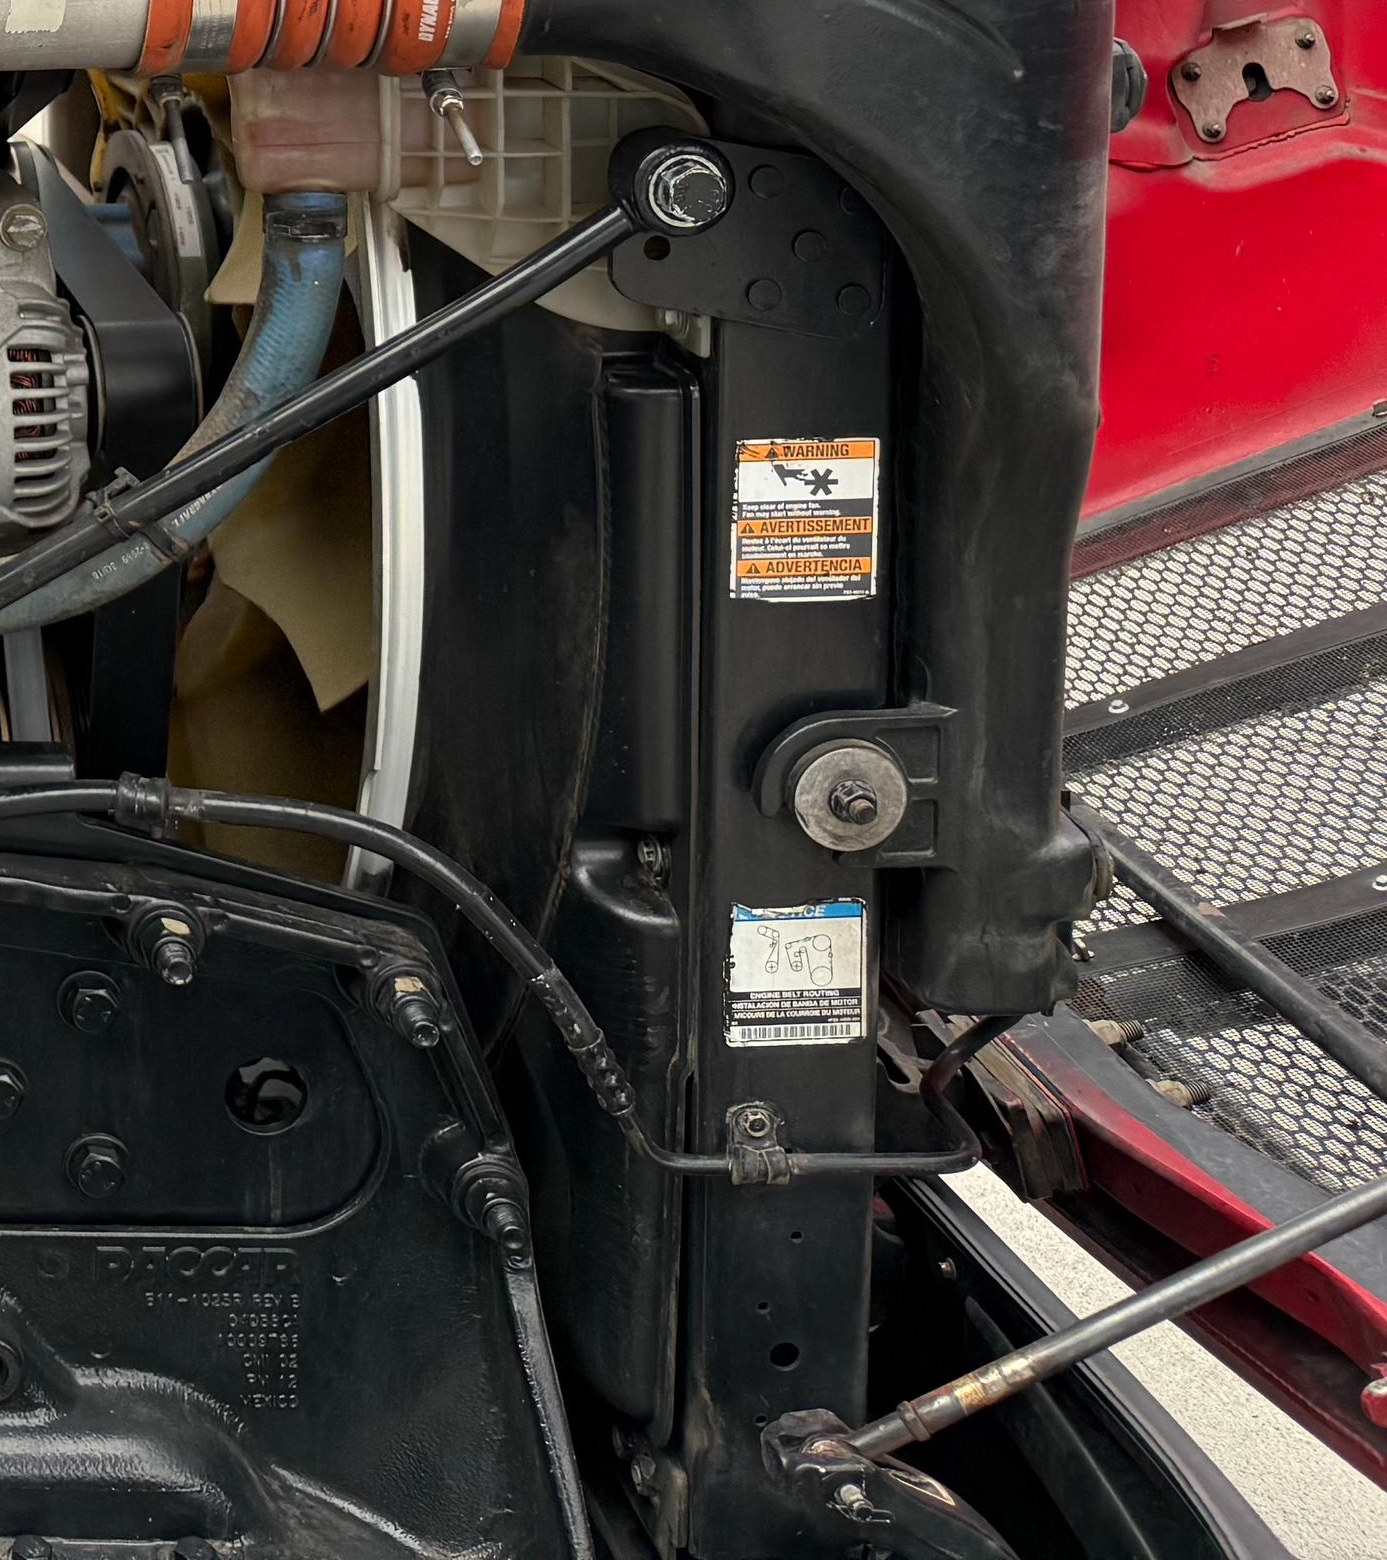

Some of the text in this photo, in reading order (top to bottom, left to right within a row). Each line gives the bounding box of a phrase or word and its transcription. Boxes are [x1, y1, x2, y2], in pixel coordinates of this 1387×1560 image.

[782, 444, 849, 458] WARNING
[760, 518, 870, 533] AVERTISSEMENT
[766, 559, 862, 573] ADVERTENCIA
[95, 1245, 300, 1287] PACCAR
